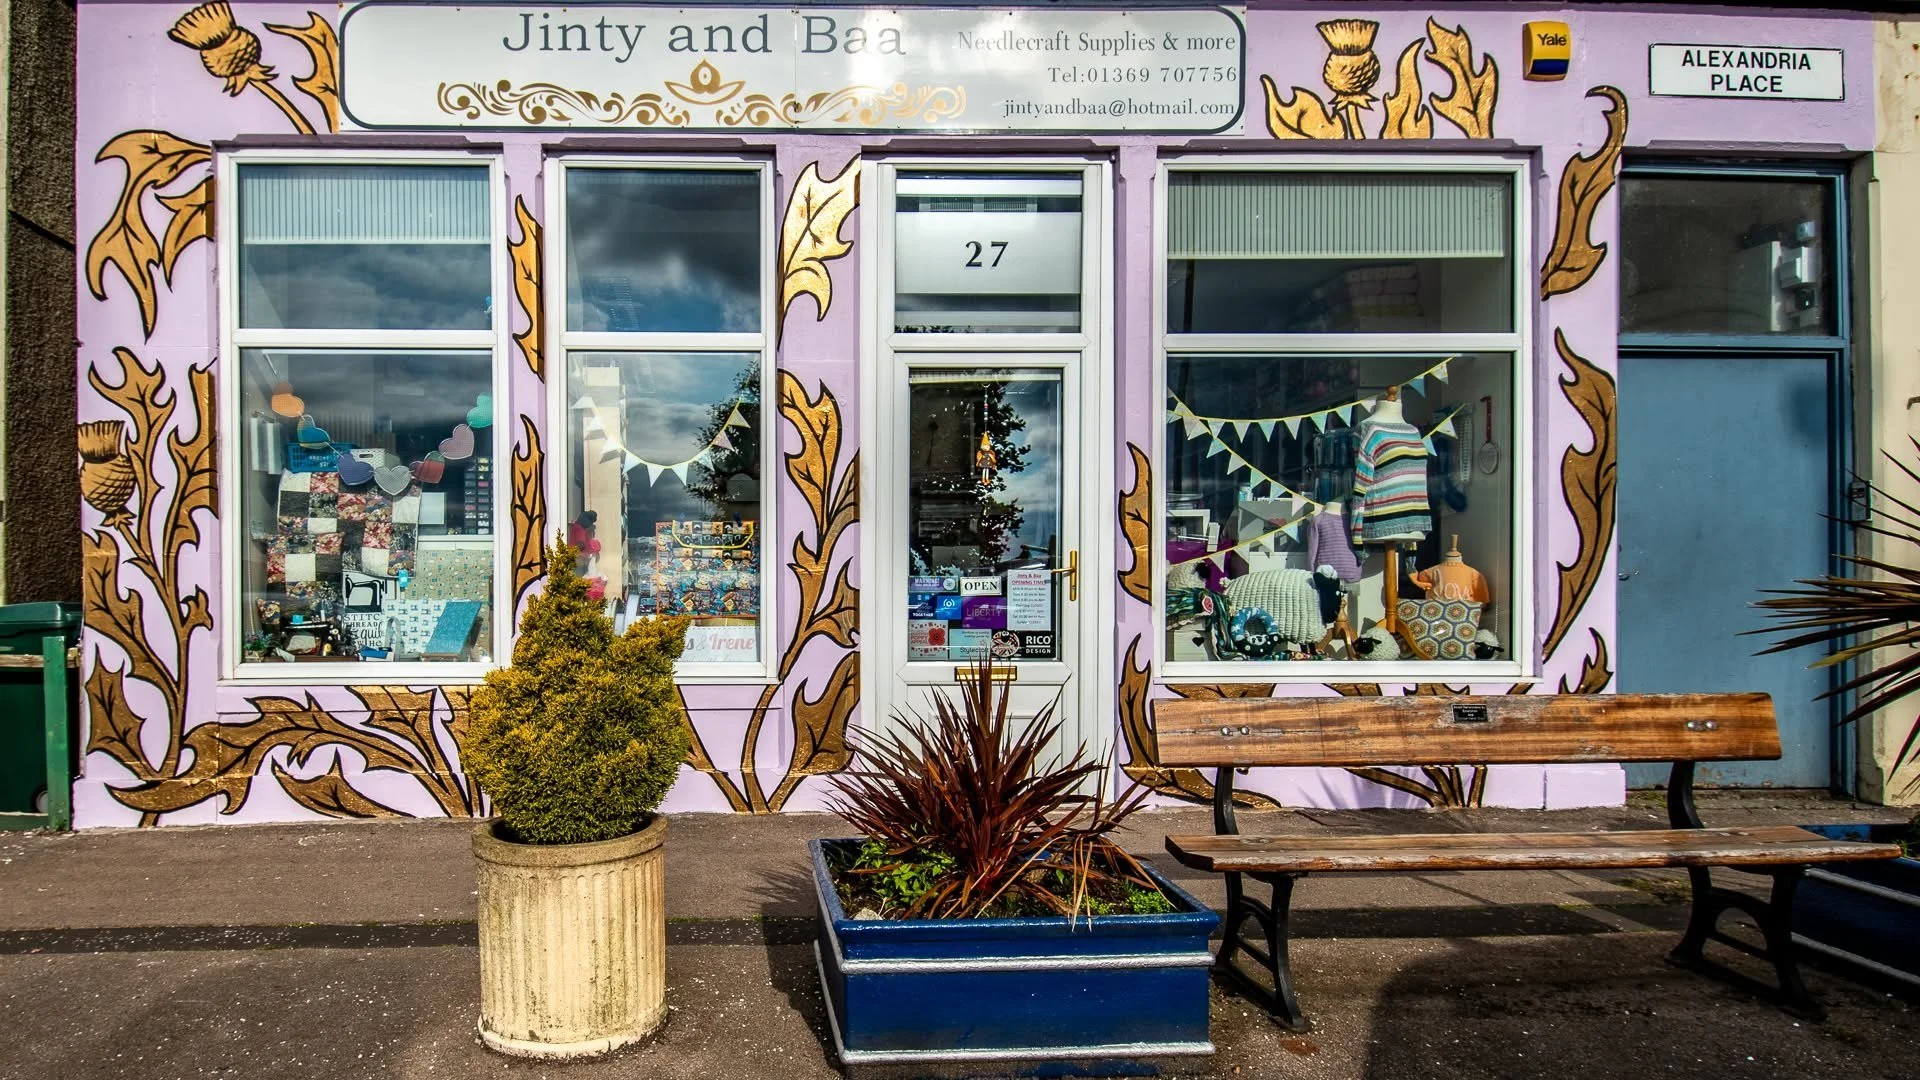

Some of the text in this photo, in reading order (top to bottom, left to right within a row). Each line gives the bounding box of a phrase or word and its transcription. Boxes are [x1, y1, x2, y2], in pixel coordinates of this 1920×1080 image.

[502, 12, 906, 63] Jinty and Baa
[958, 30, 1236, 57] Needlecraft Supplies & more
[1537, 32, 1568, 47] Yale
[1681, 50, 1812, 71] ALEXANDRIA
[1047, 66, 1237, 83] Tel:01369 707756
[1710, 74, 1784, 93] PLACE
[1002, 98, 1235, 119] jintyandbaa@hotmail.com
[965, 240, 1009, 267] 27
[964, 581, 999, 592] OPEN
[966, 607, 1002, 617] LIBERTY
[708, 633, 754, 650] Irene
[1025, 635, 1051, 645] RICO
